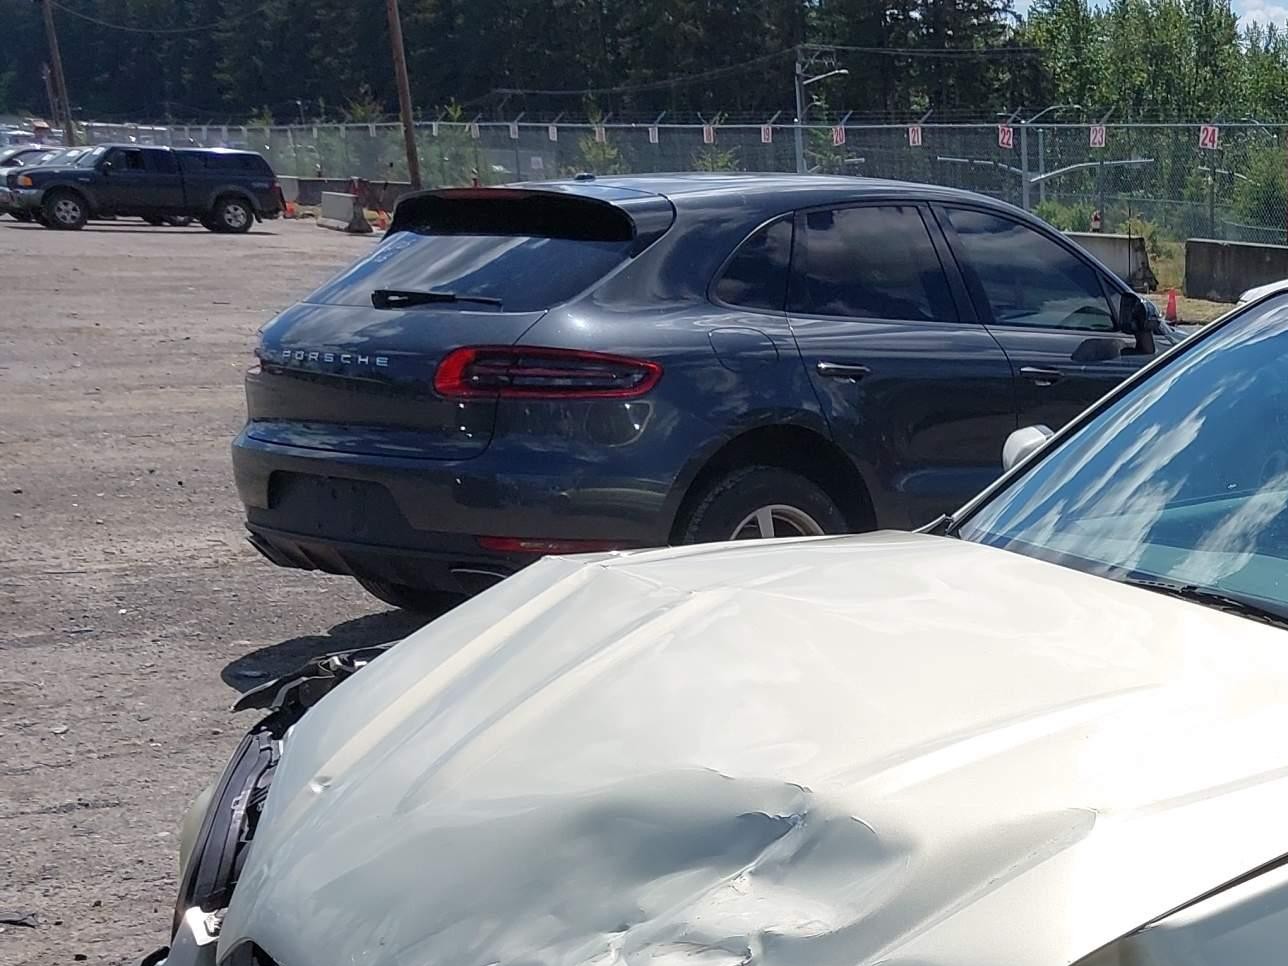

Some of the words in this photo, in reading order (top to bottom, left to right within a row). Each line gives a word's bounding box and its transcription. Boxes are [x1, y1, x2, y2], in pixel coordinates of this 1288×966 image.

[764, 127, 771, 141] 19
[835, 127, 844, 144] 20
[911, 127, 920, 144] 21
[1000, 127, 1012, 145] 22
[1092, 127, 1104, 146] 23
[1201, 127, 1216, 147] 24
[283, 350, 389, 366] PORSCHE
